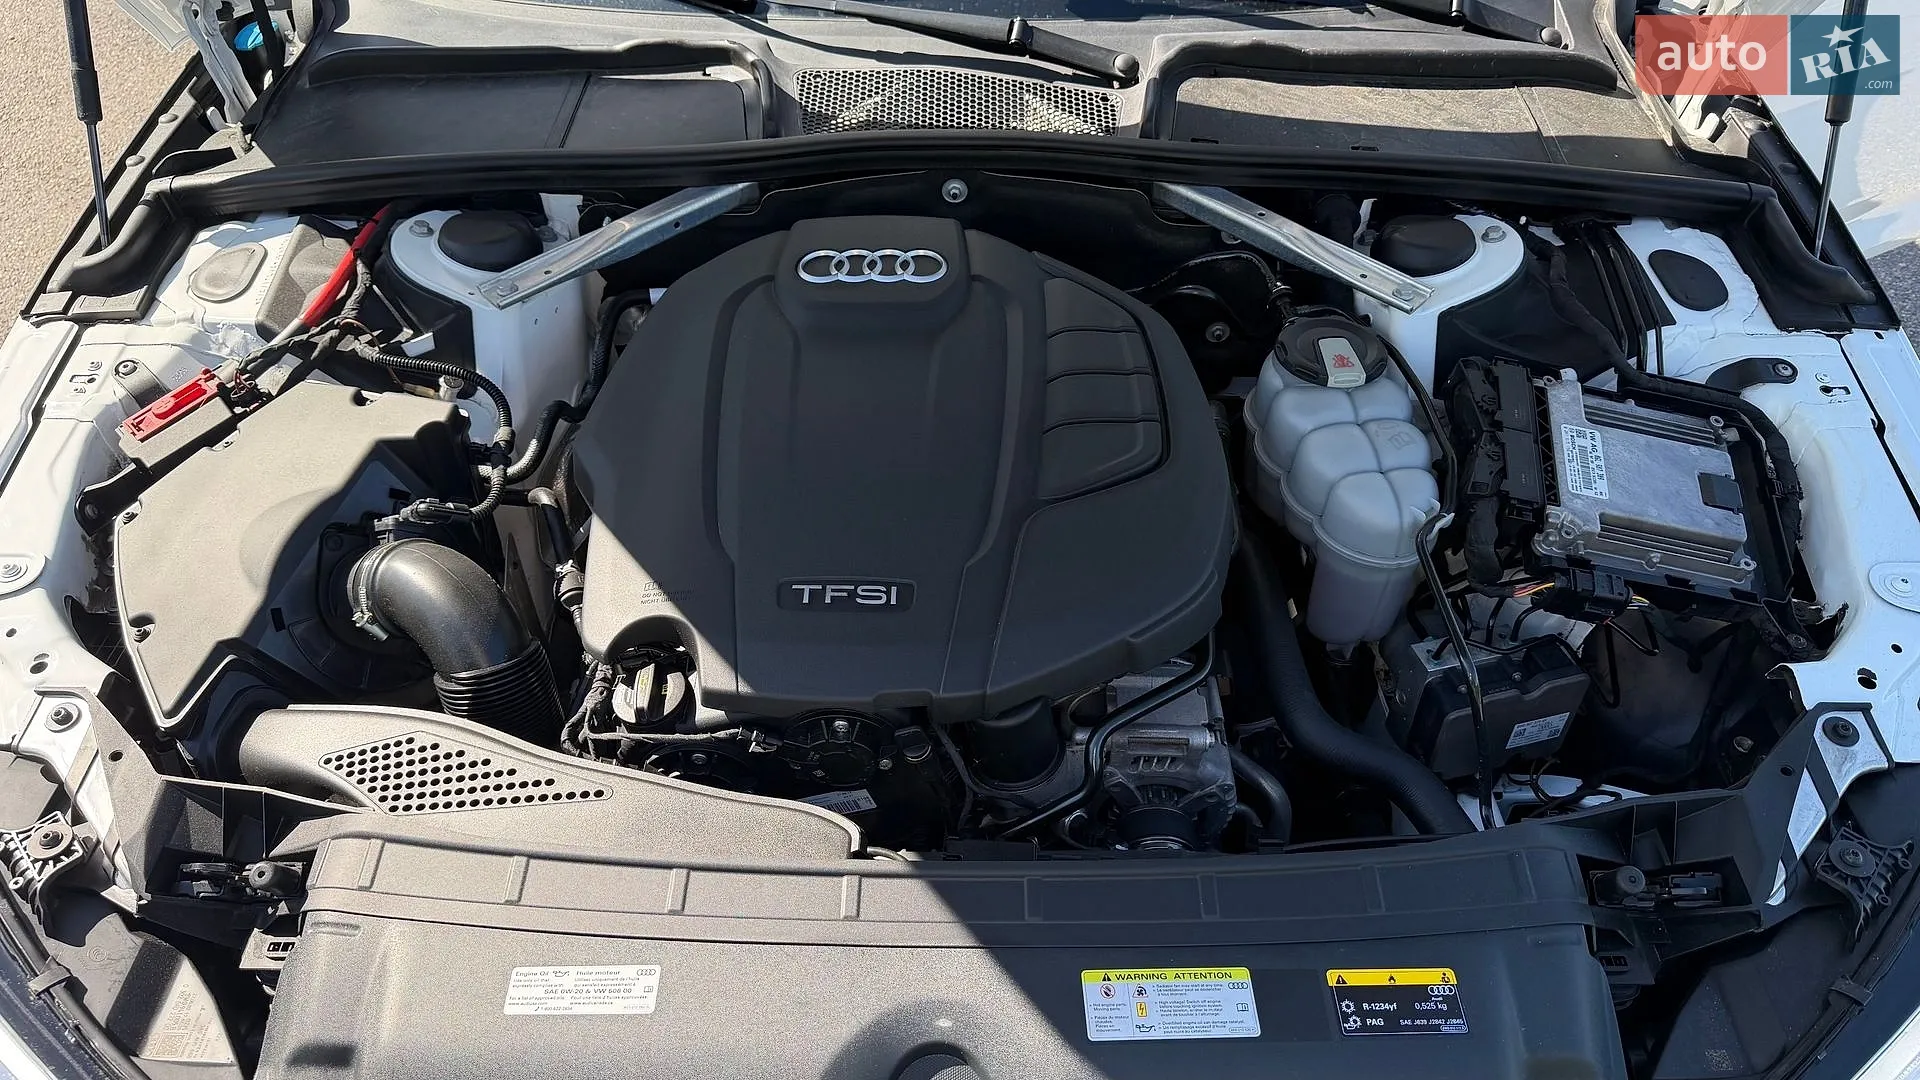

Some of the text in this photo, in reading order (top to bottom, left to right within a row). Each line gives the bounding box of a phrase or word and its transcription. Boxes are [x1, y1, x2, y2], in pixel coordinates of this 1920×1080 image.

[1590, 443, 1598, 452] AG
[792, 584, 897, 604] TFSI
[1362, 1003, 1397, 1011] R-1234yf
[1438, 1002, 1448, 1011] kg
